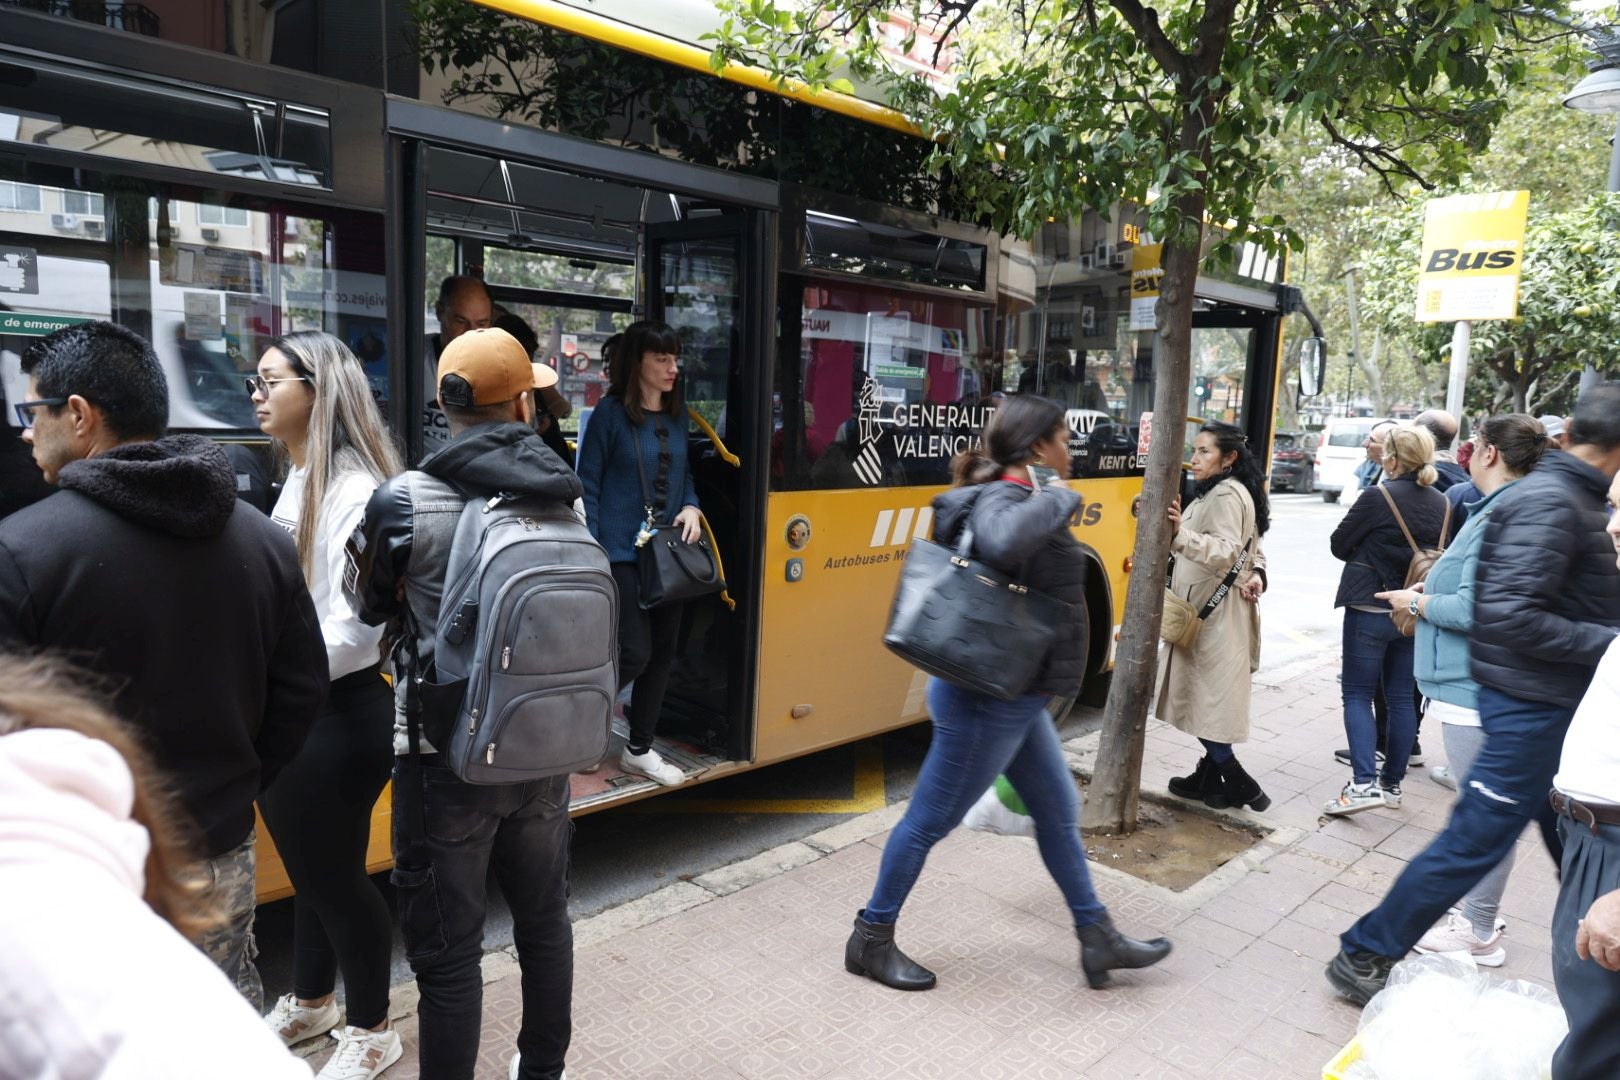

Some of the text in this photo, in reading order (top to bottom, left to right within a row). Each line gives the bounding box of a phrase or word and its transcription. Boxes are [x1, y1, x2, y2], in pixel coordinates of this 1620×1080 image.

[1425, 248, 1516, 273] Bus
[4, 317, 20, 327] de
[893, 403, 996, 428] GENERALIT
[893, 434, 984, 458] VALENCIA
[1099, 455, 1127, 470] KENT
[1065, 503, 1103, 527] us
[824, 553, 890, 570] Autobuses
[1207, 583, 1229, 608] BIMBA
